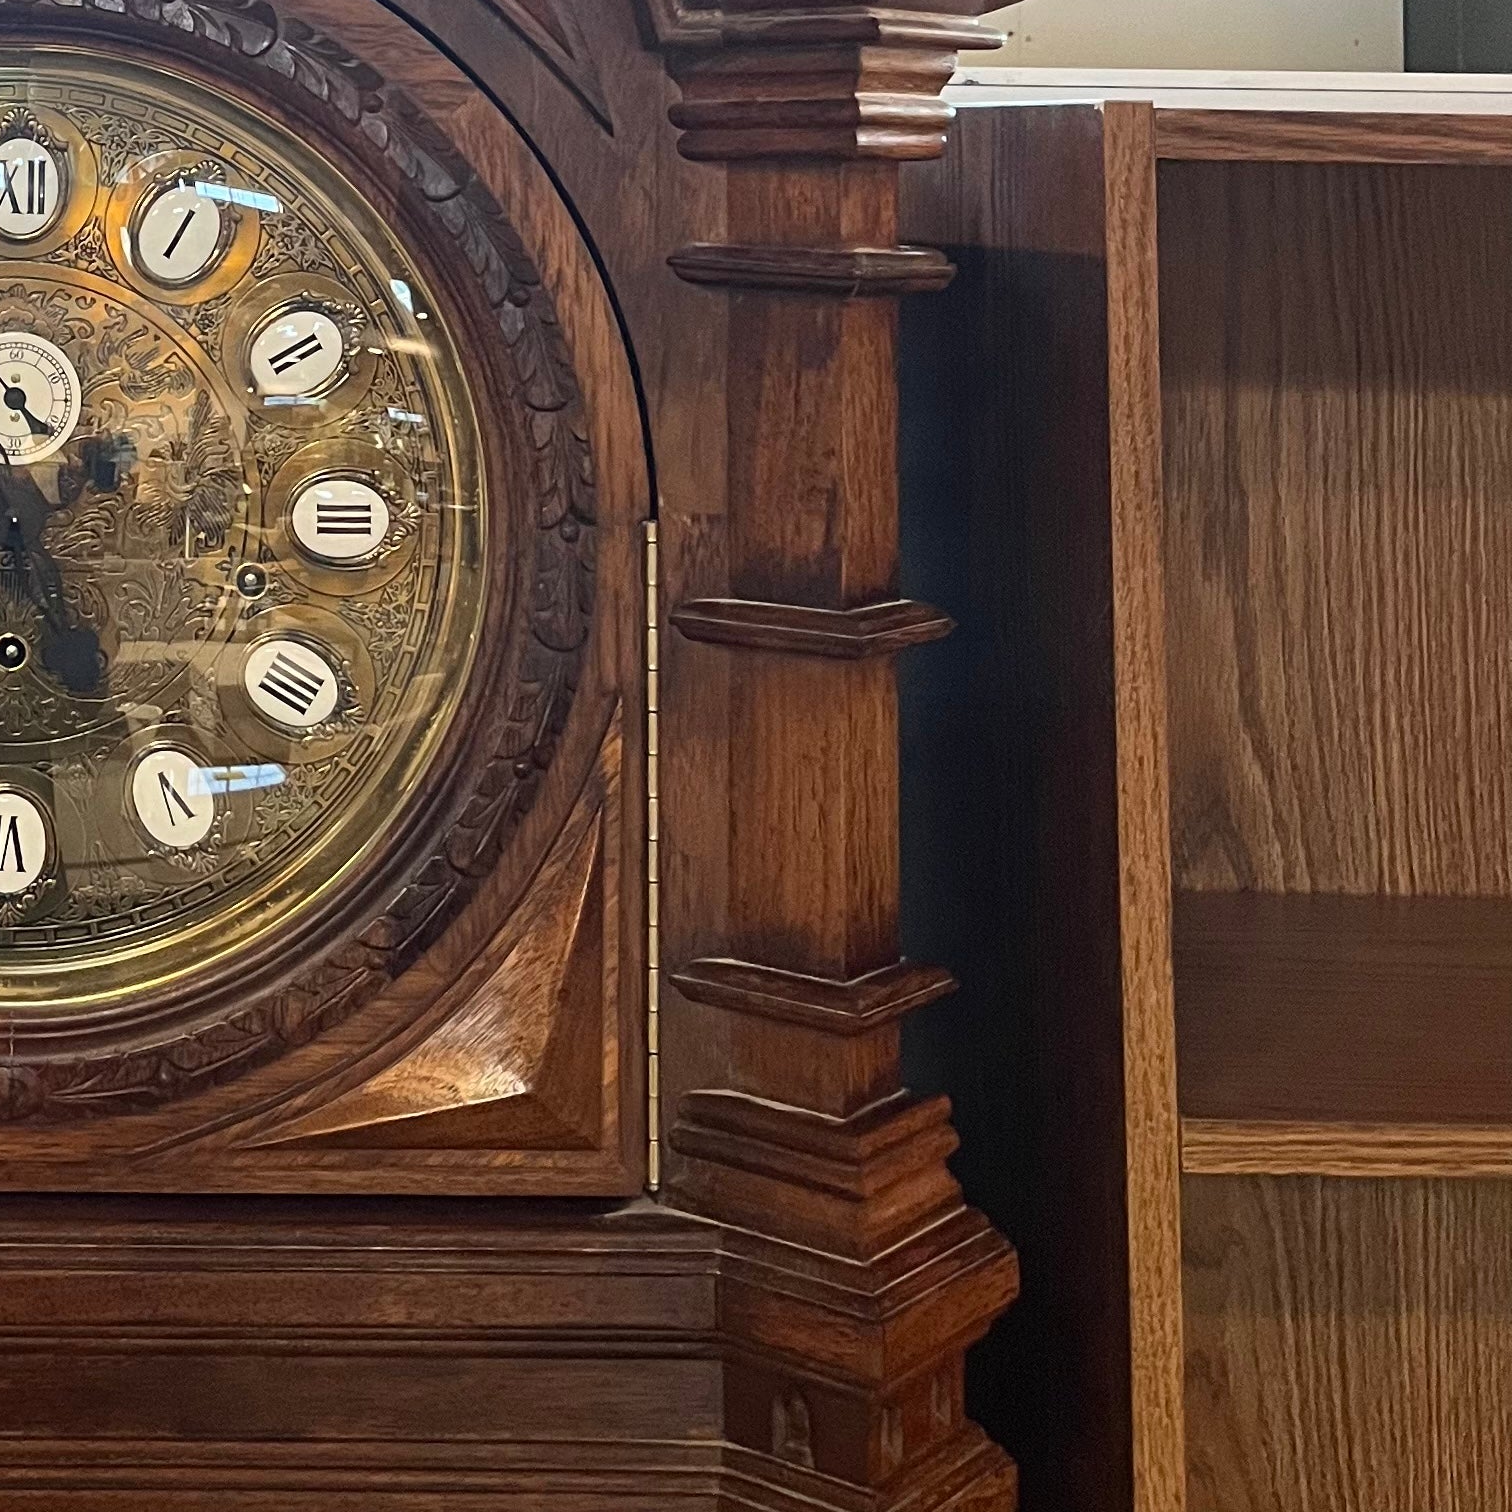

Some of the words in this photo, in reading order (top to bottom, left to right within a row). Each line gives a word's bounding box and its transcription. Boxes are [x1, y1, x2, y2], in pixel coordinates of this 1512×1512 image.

[9, 349, 25, 360] 60
[47, 371, 61, 385] 10
[7, 438, 22, 448] 30
